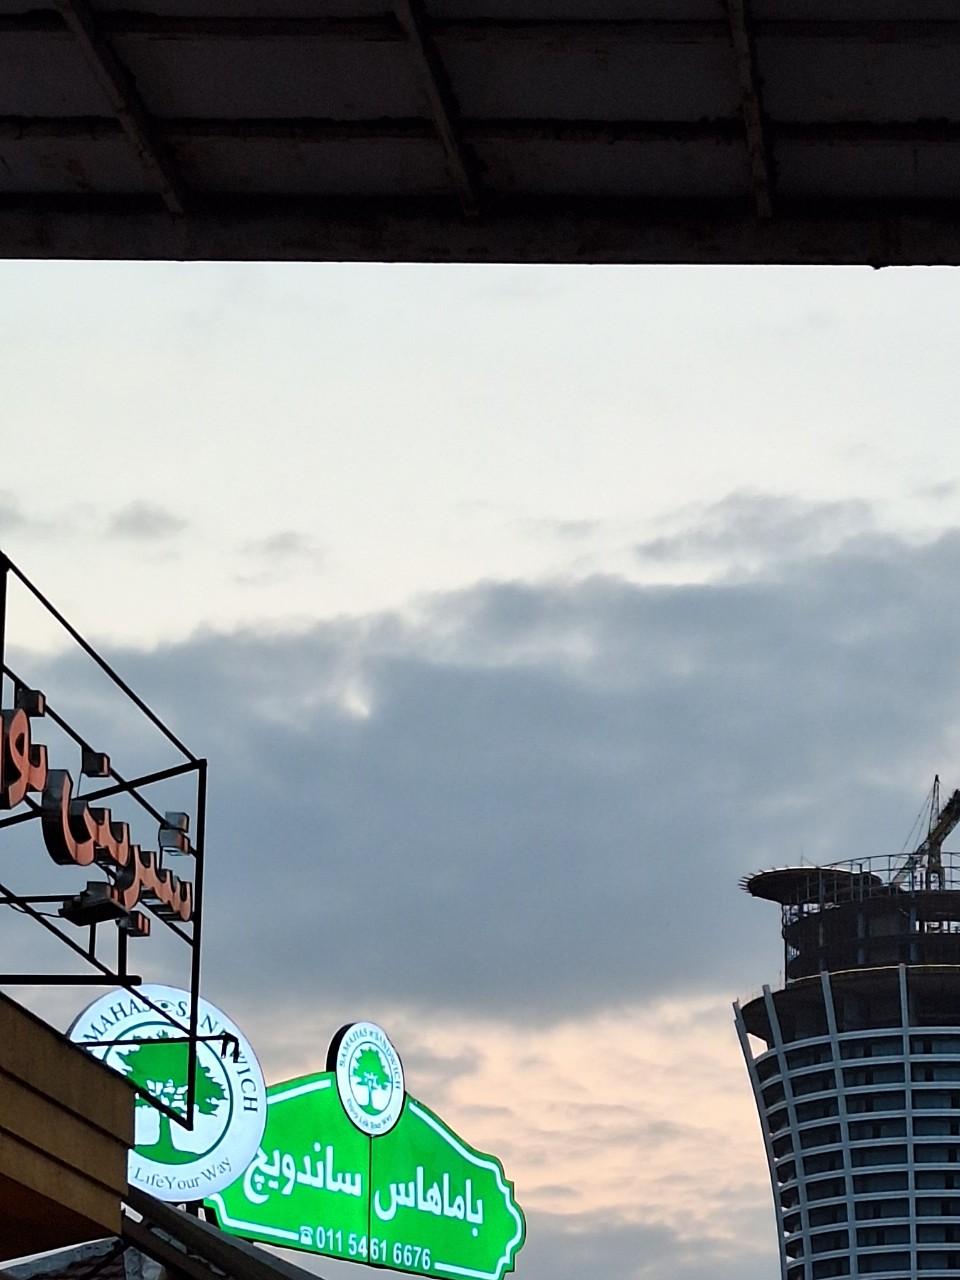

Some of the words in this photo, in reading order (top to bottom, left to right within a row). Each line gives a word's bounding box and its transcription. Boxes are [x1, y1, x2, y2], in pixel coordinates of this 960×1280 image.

[200, 1156, 233, 1183] Way
[242, 1141, 362, 1204] ساندویچ
[374, 1166, 484, 1237] باماهاس
[316, 1225, 343, 1252] 011
[347, 1231, 388, 1261] 5461
[392, 1241, 431, 1271] 6676
